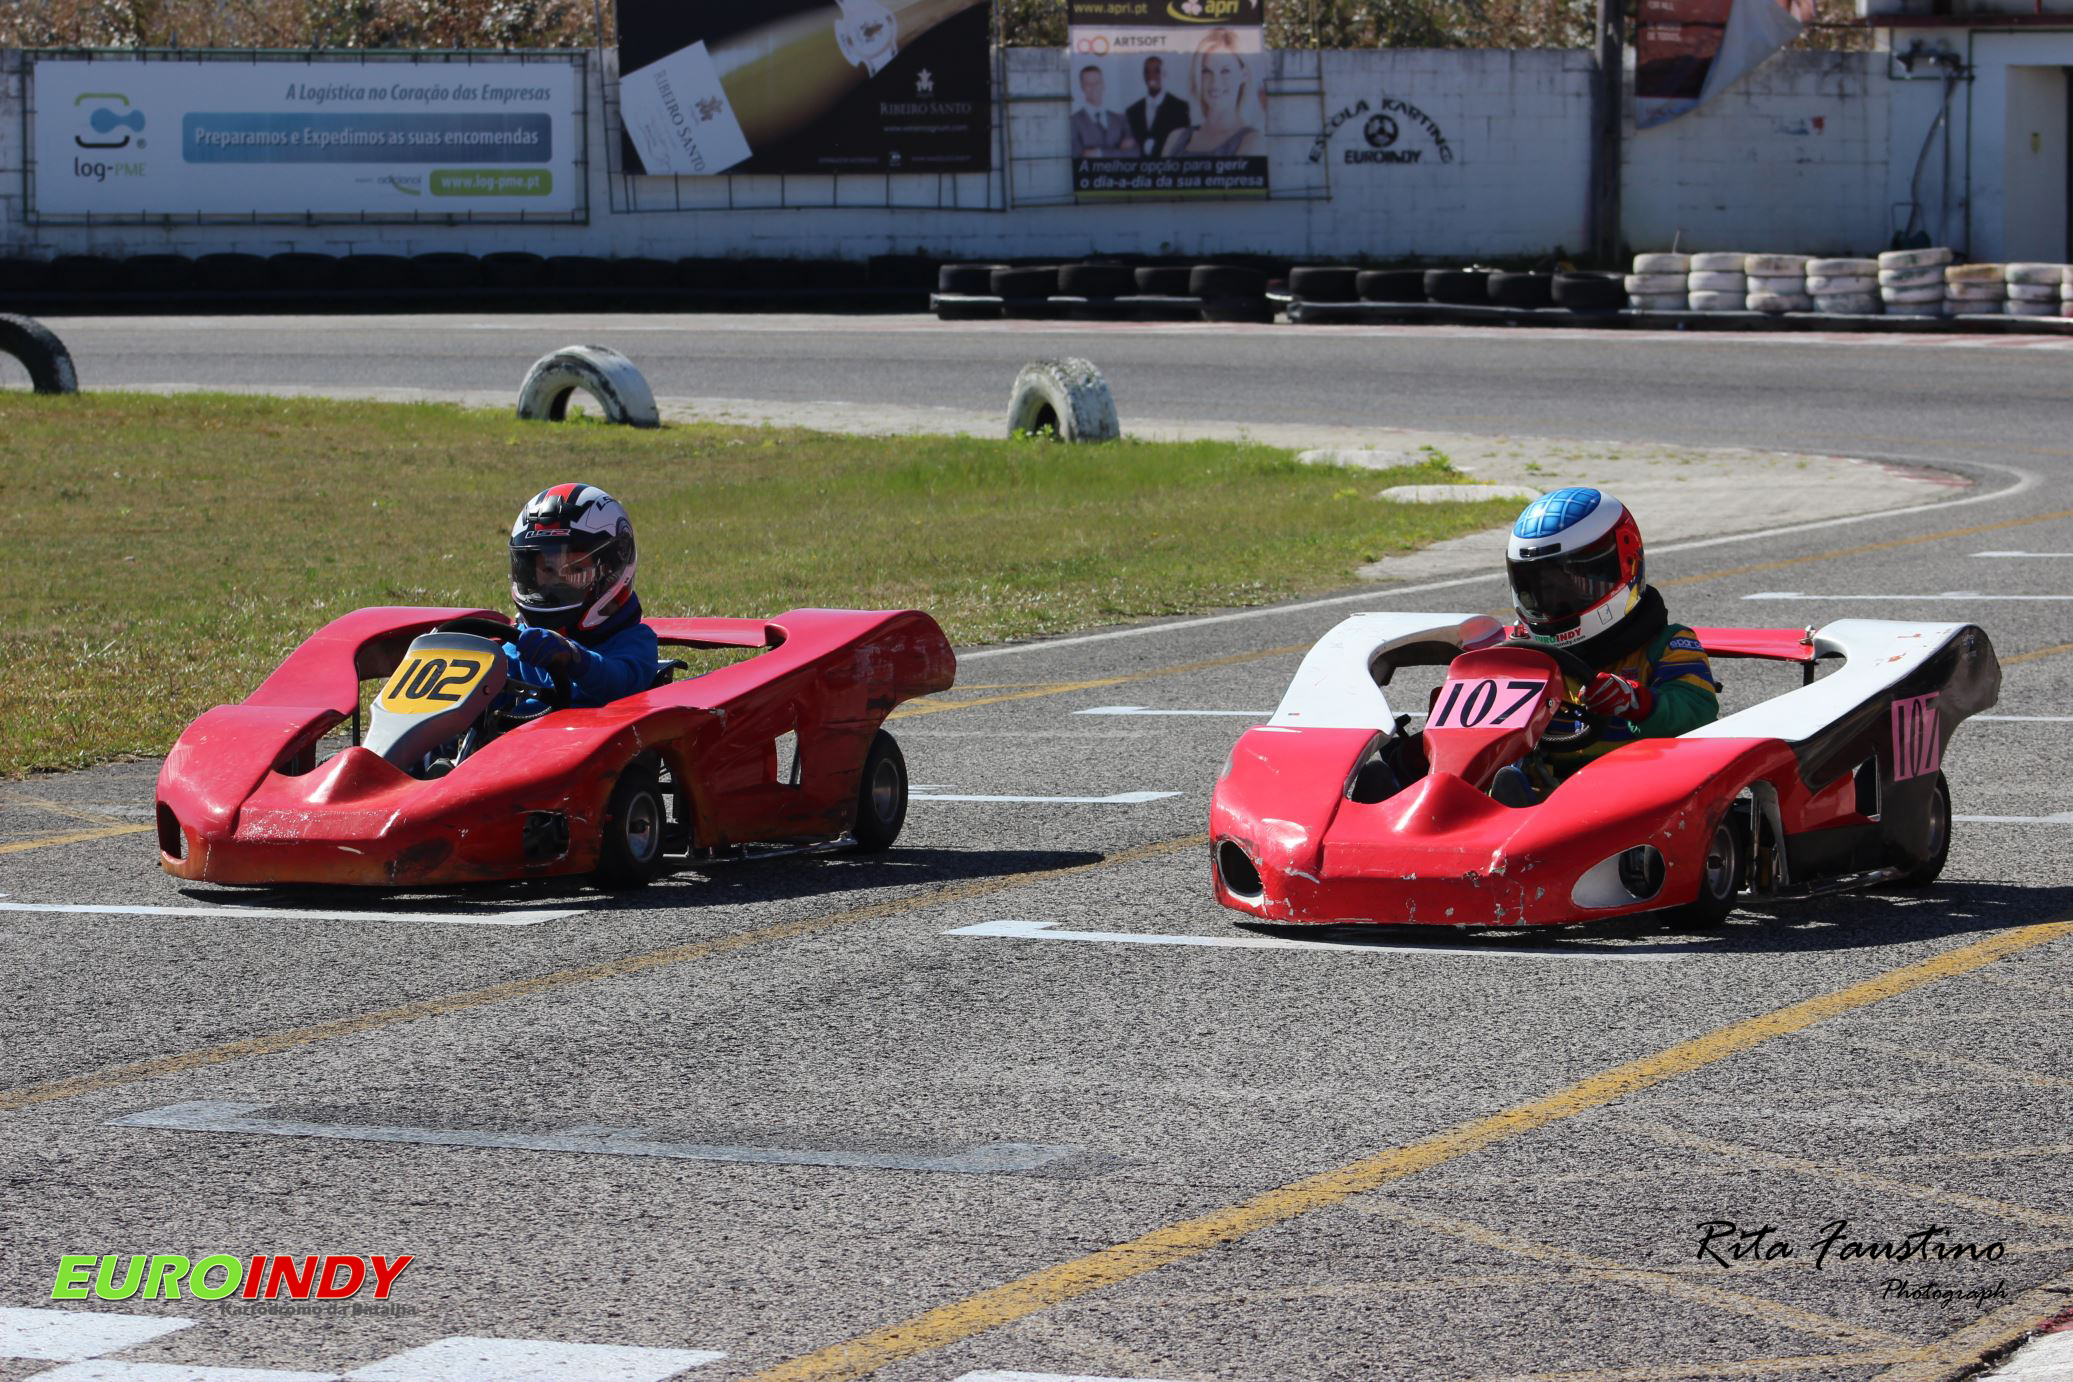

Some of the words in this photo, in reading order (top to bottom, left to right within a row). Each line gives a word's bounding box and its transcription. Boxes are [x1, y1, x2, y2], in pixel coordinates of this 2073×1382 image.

[1073, 2, 1147, 16] www.apri.pt
[1204, 0, 1239, 17] apri
[1113, 36, 1167, 47] ARTSOFT
[286, 84, 296, 100] A
[300, 83, 365, 105] Logística
[368, 87, 387, 101] no
[391, 84, 450, 105] Coração
[452, 84, 478, 101] das
[481, 84, 551, 105] Empresas
[880, 101, 929, 116] RIBEIRO
[930, 101, 972, 115] SANTO
[654, 69, 685, 127] RIBEIRO
[676, 127, 706, 173] SANTO
[1382, 98, 1454, 164] KARTING
[195, 128, 288, 149] Preparamos
[291, 133, 299, 145] e
[304, 127, 386, 149] Expedimos
[389, 132, 405, 145] as
[408, 132, 441, 145] suas
[445, 127, 539, 145] encomendas
[1079, 160, 1089, 172] A
[1092, 159, 1137, 172] melhor
[1140, 159, 1180, 175] opção
[1182, 162, 1212, 174] para
[1215, 159, 1249, 174] gerir
[1344, 149, 1422, 165] EUROINDY
[74, 156, 147, 183] log-PME
[441, 173, 541, 191] www.log-pme.pt
[1080, 178, 1089, 188] o
[1093, 176, 1151, 188] dia-a-dia
[1155, 176, 1173, 188] da
[1176, 177, 1201, 188] sua
[1205, 175, 1264, 188] empresa
[388, 658, 481, 702] 102
[1435, 679, 1546, 728] 107
[1897, 697, 1938, 778] 107
